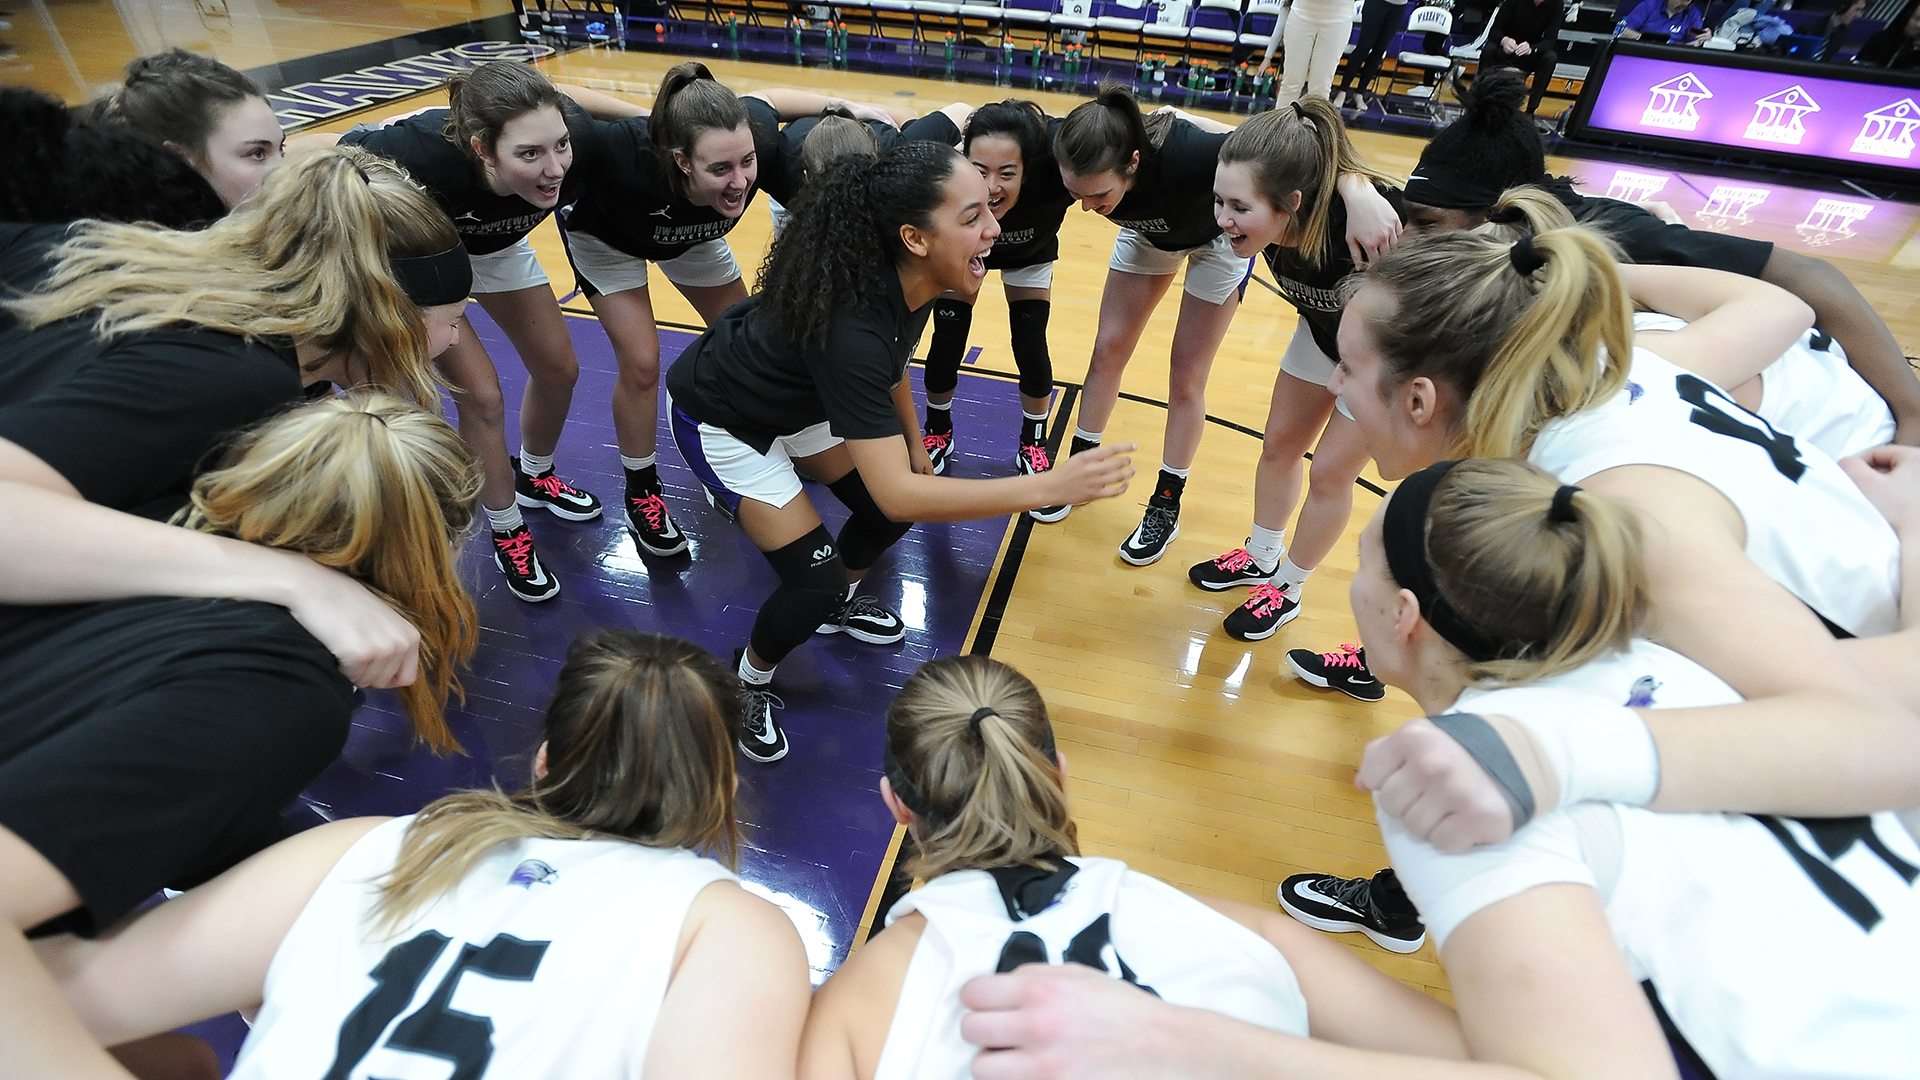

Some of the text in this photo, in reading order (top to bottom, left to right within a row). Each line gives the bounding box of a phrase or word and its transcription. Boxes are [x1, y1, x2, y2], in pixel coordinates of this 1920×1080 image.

[1648, 91, 1704, 119] DLK
[1752, 104, 1809, 132] DLK
[654, 218, 735, 237] UW-WHITEWATER
[999, 227, 1035, 240] EWATER
[322, 928, 553, 1080] 15
